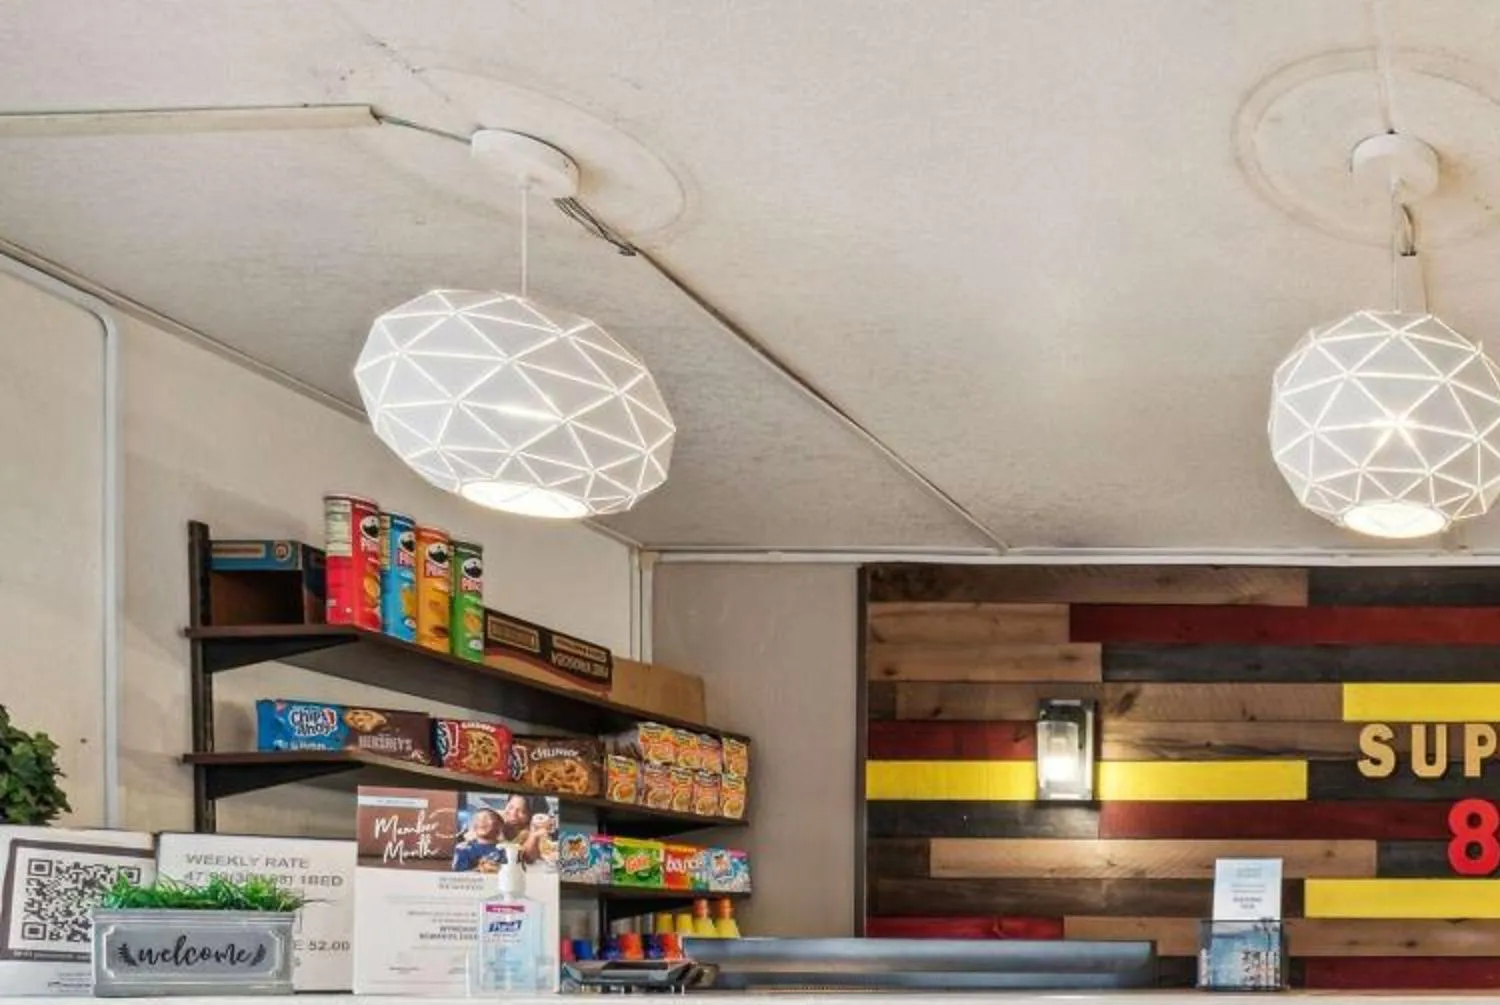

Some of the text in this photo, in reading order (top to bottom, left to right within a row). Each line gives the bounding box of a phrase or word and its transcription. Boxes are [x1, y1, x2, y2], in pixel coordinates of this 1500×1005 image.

[374, 810, 441, 842] Member
[185, 853, 311, 869] WEEKLY RATE
[383, 835, 439, 864] Month
[139, 935, 250, 967] welcome
[309, 941, 351, 952] 52.00
